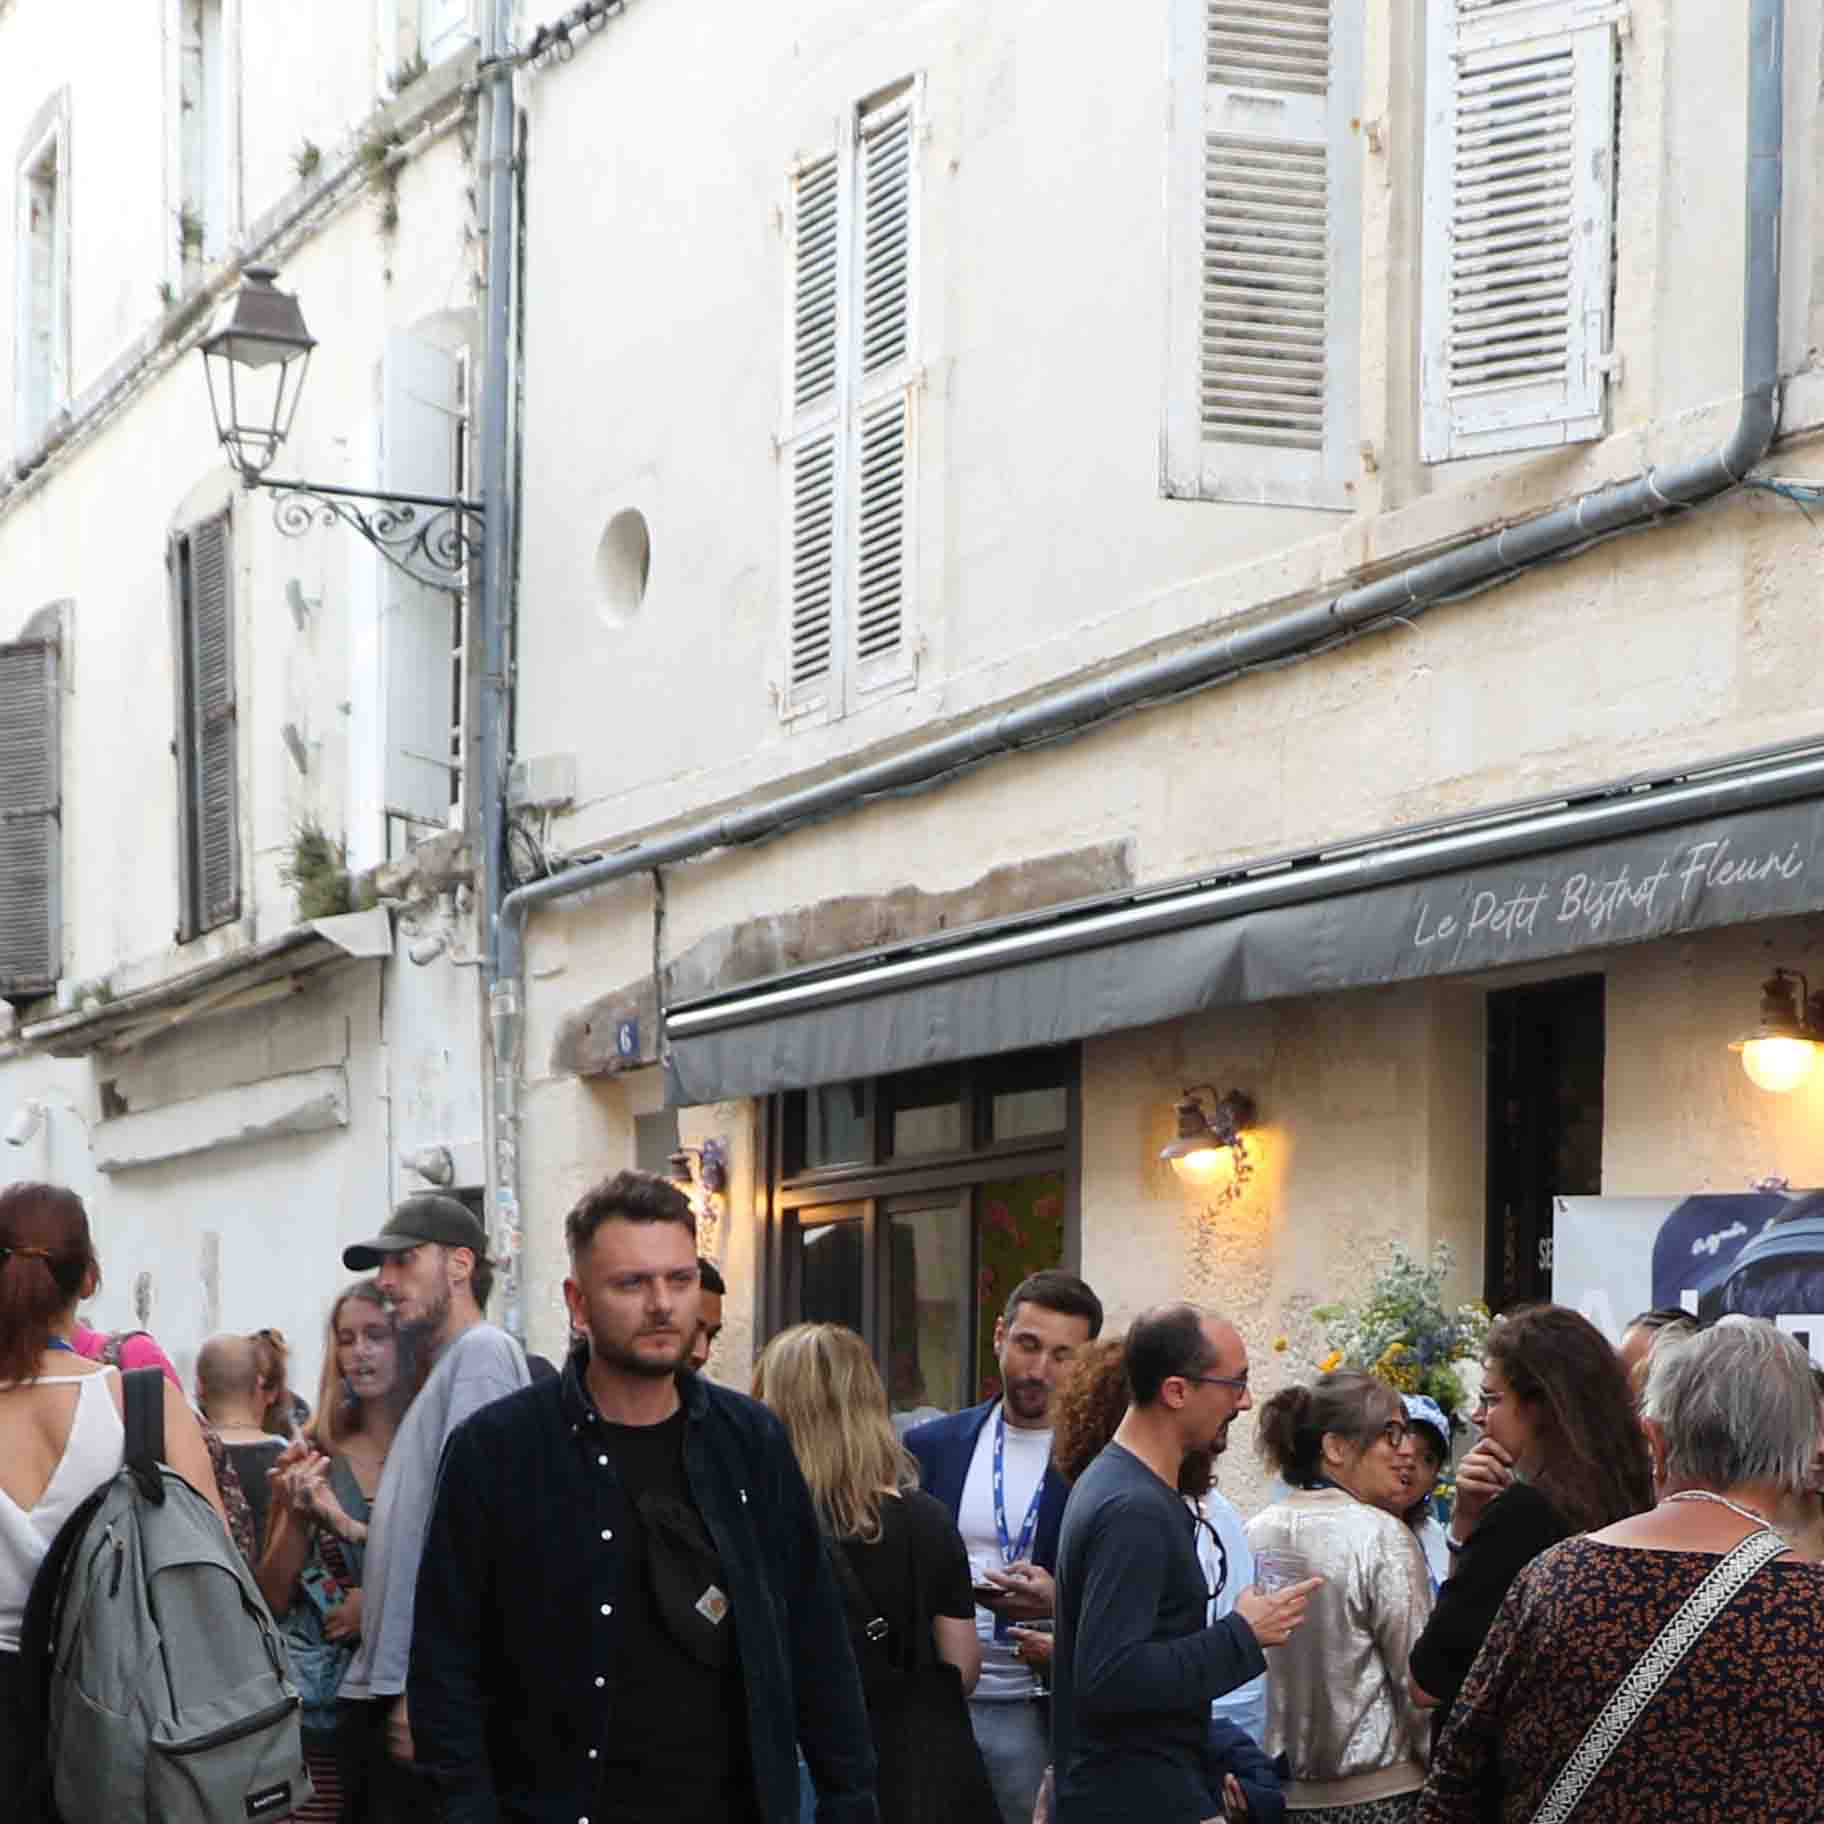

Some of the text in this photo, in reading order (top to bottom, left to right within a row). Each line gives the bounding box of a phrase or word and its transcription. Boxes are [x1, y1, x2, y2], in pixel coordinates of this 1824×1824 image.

[1414, 837, 1803, 945] Le Petit Bistrot Fleuri
[620, 1023, 633, 1051] 6
